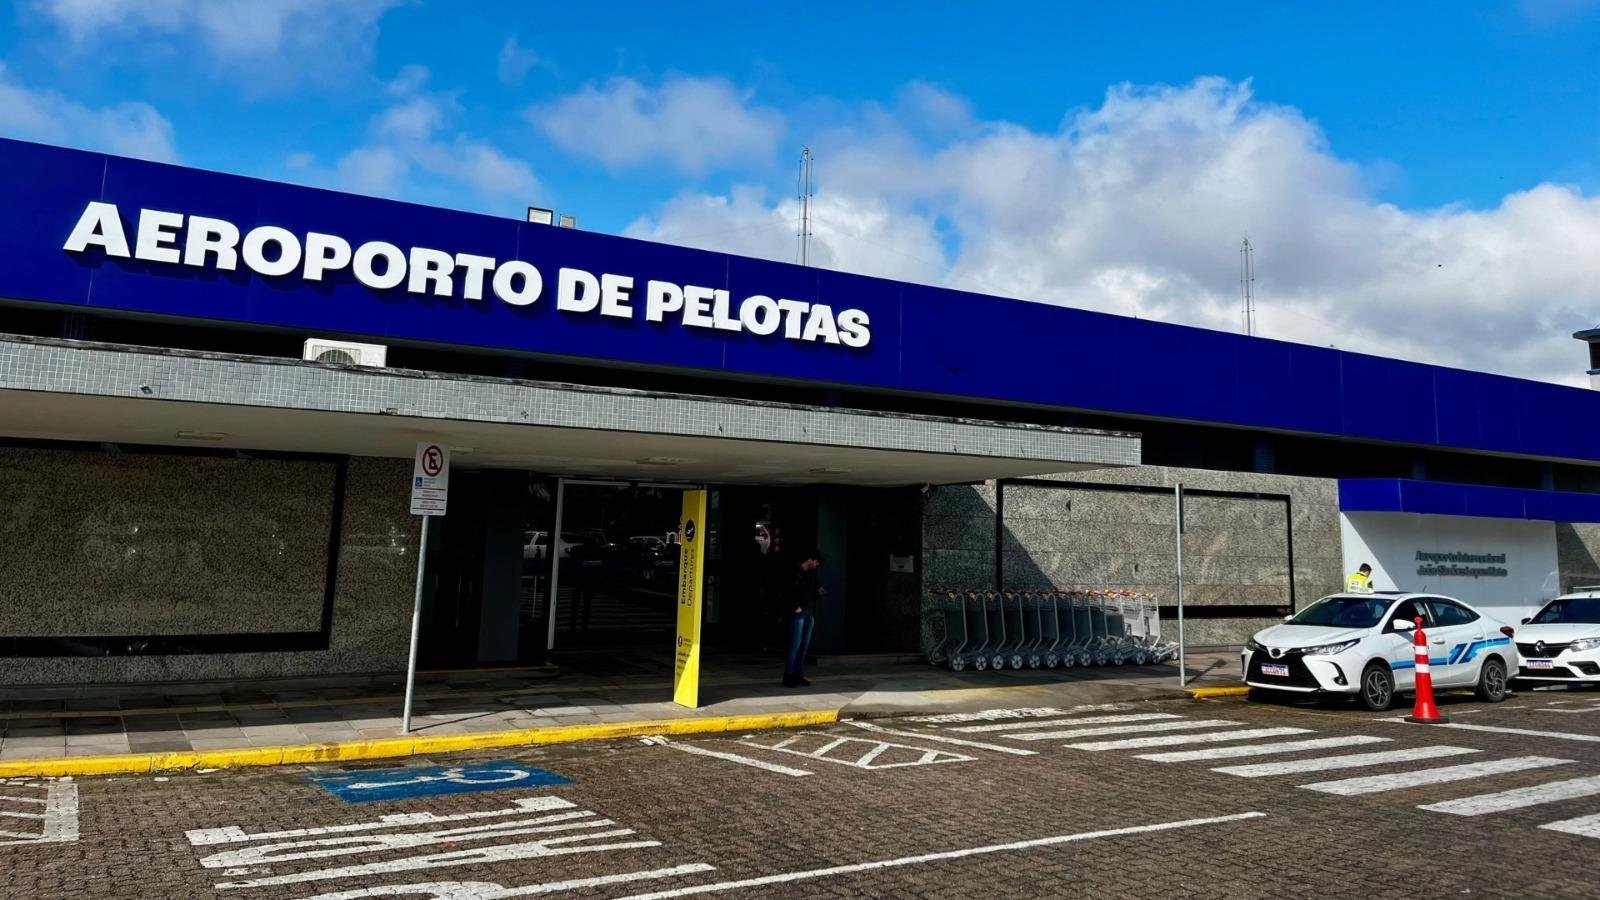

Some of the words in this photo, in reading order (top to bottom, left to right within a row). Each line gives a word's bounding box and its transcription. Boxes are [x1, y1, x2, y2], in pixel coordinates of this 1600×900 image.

[62, 201, 543, 307] AEROPORTO
[556, 267, 634, 319] DE
[645, 279, 871, 348] PELOTAS
[687, 548, 695, 607] Departures
